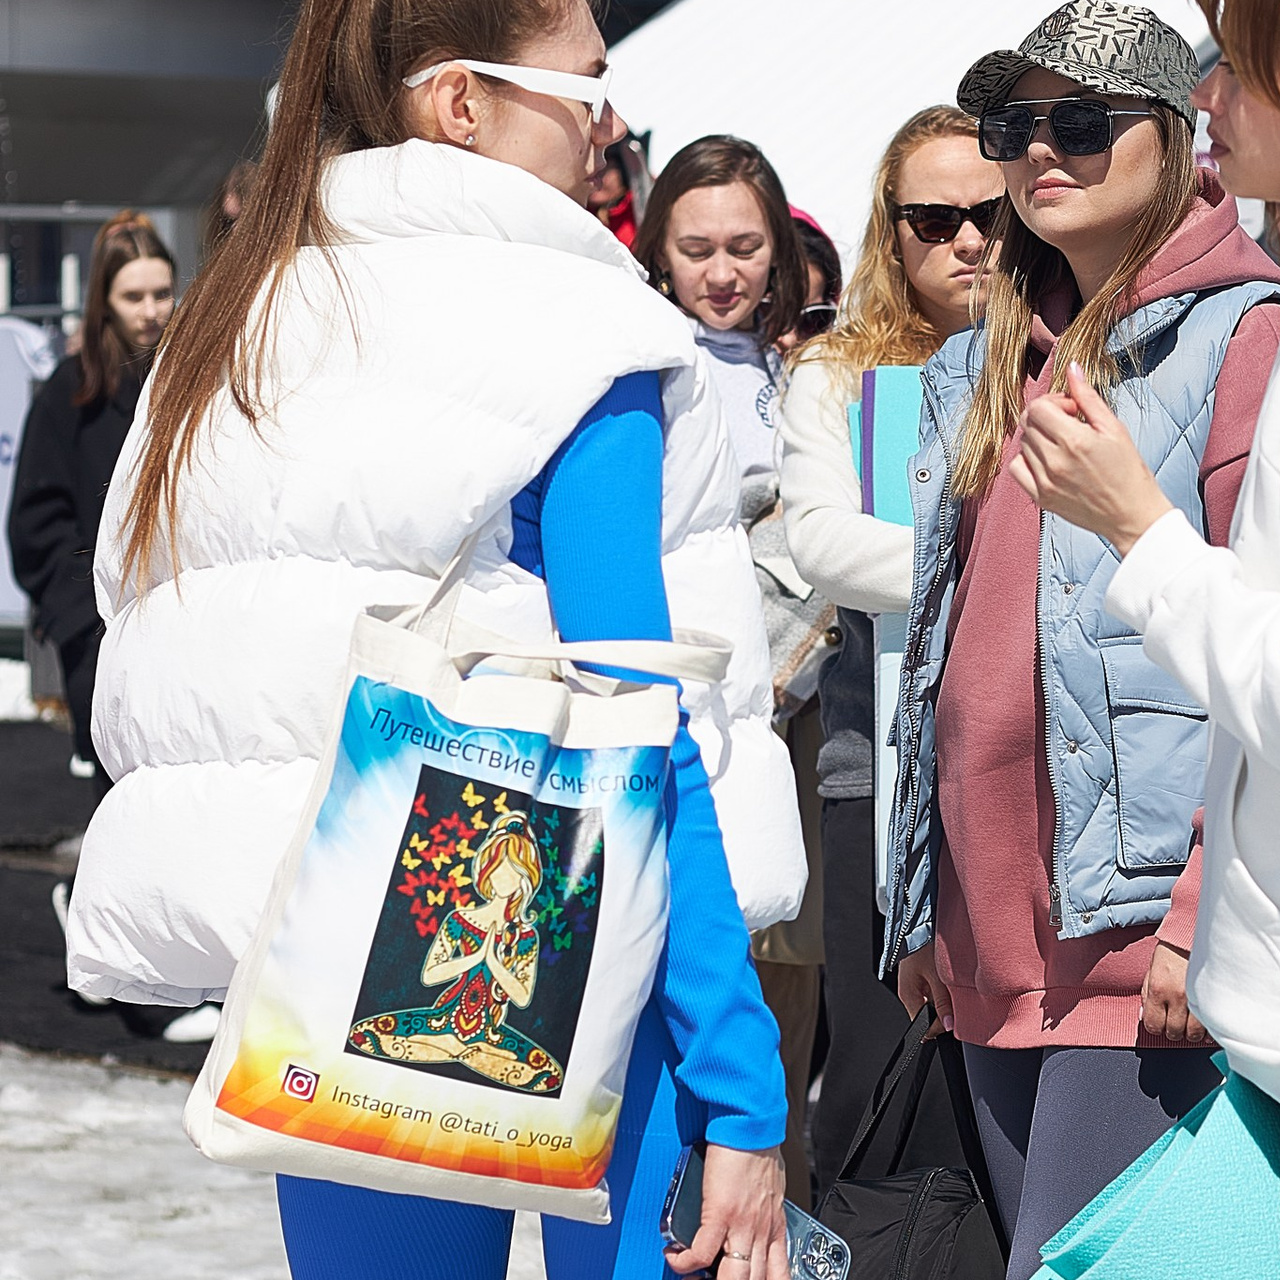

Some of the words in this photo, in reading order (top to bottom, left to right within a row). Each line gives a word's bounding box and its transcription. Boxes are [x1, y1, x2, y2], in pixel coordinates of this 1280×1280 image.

[369, 706, 536, 779] Путешествие
[549, 773, 660, 794] смыслом
[331, 1085, 432, 1124] Instagram
[439, 1112, 573, 1152] @tati_o_yoga
